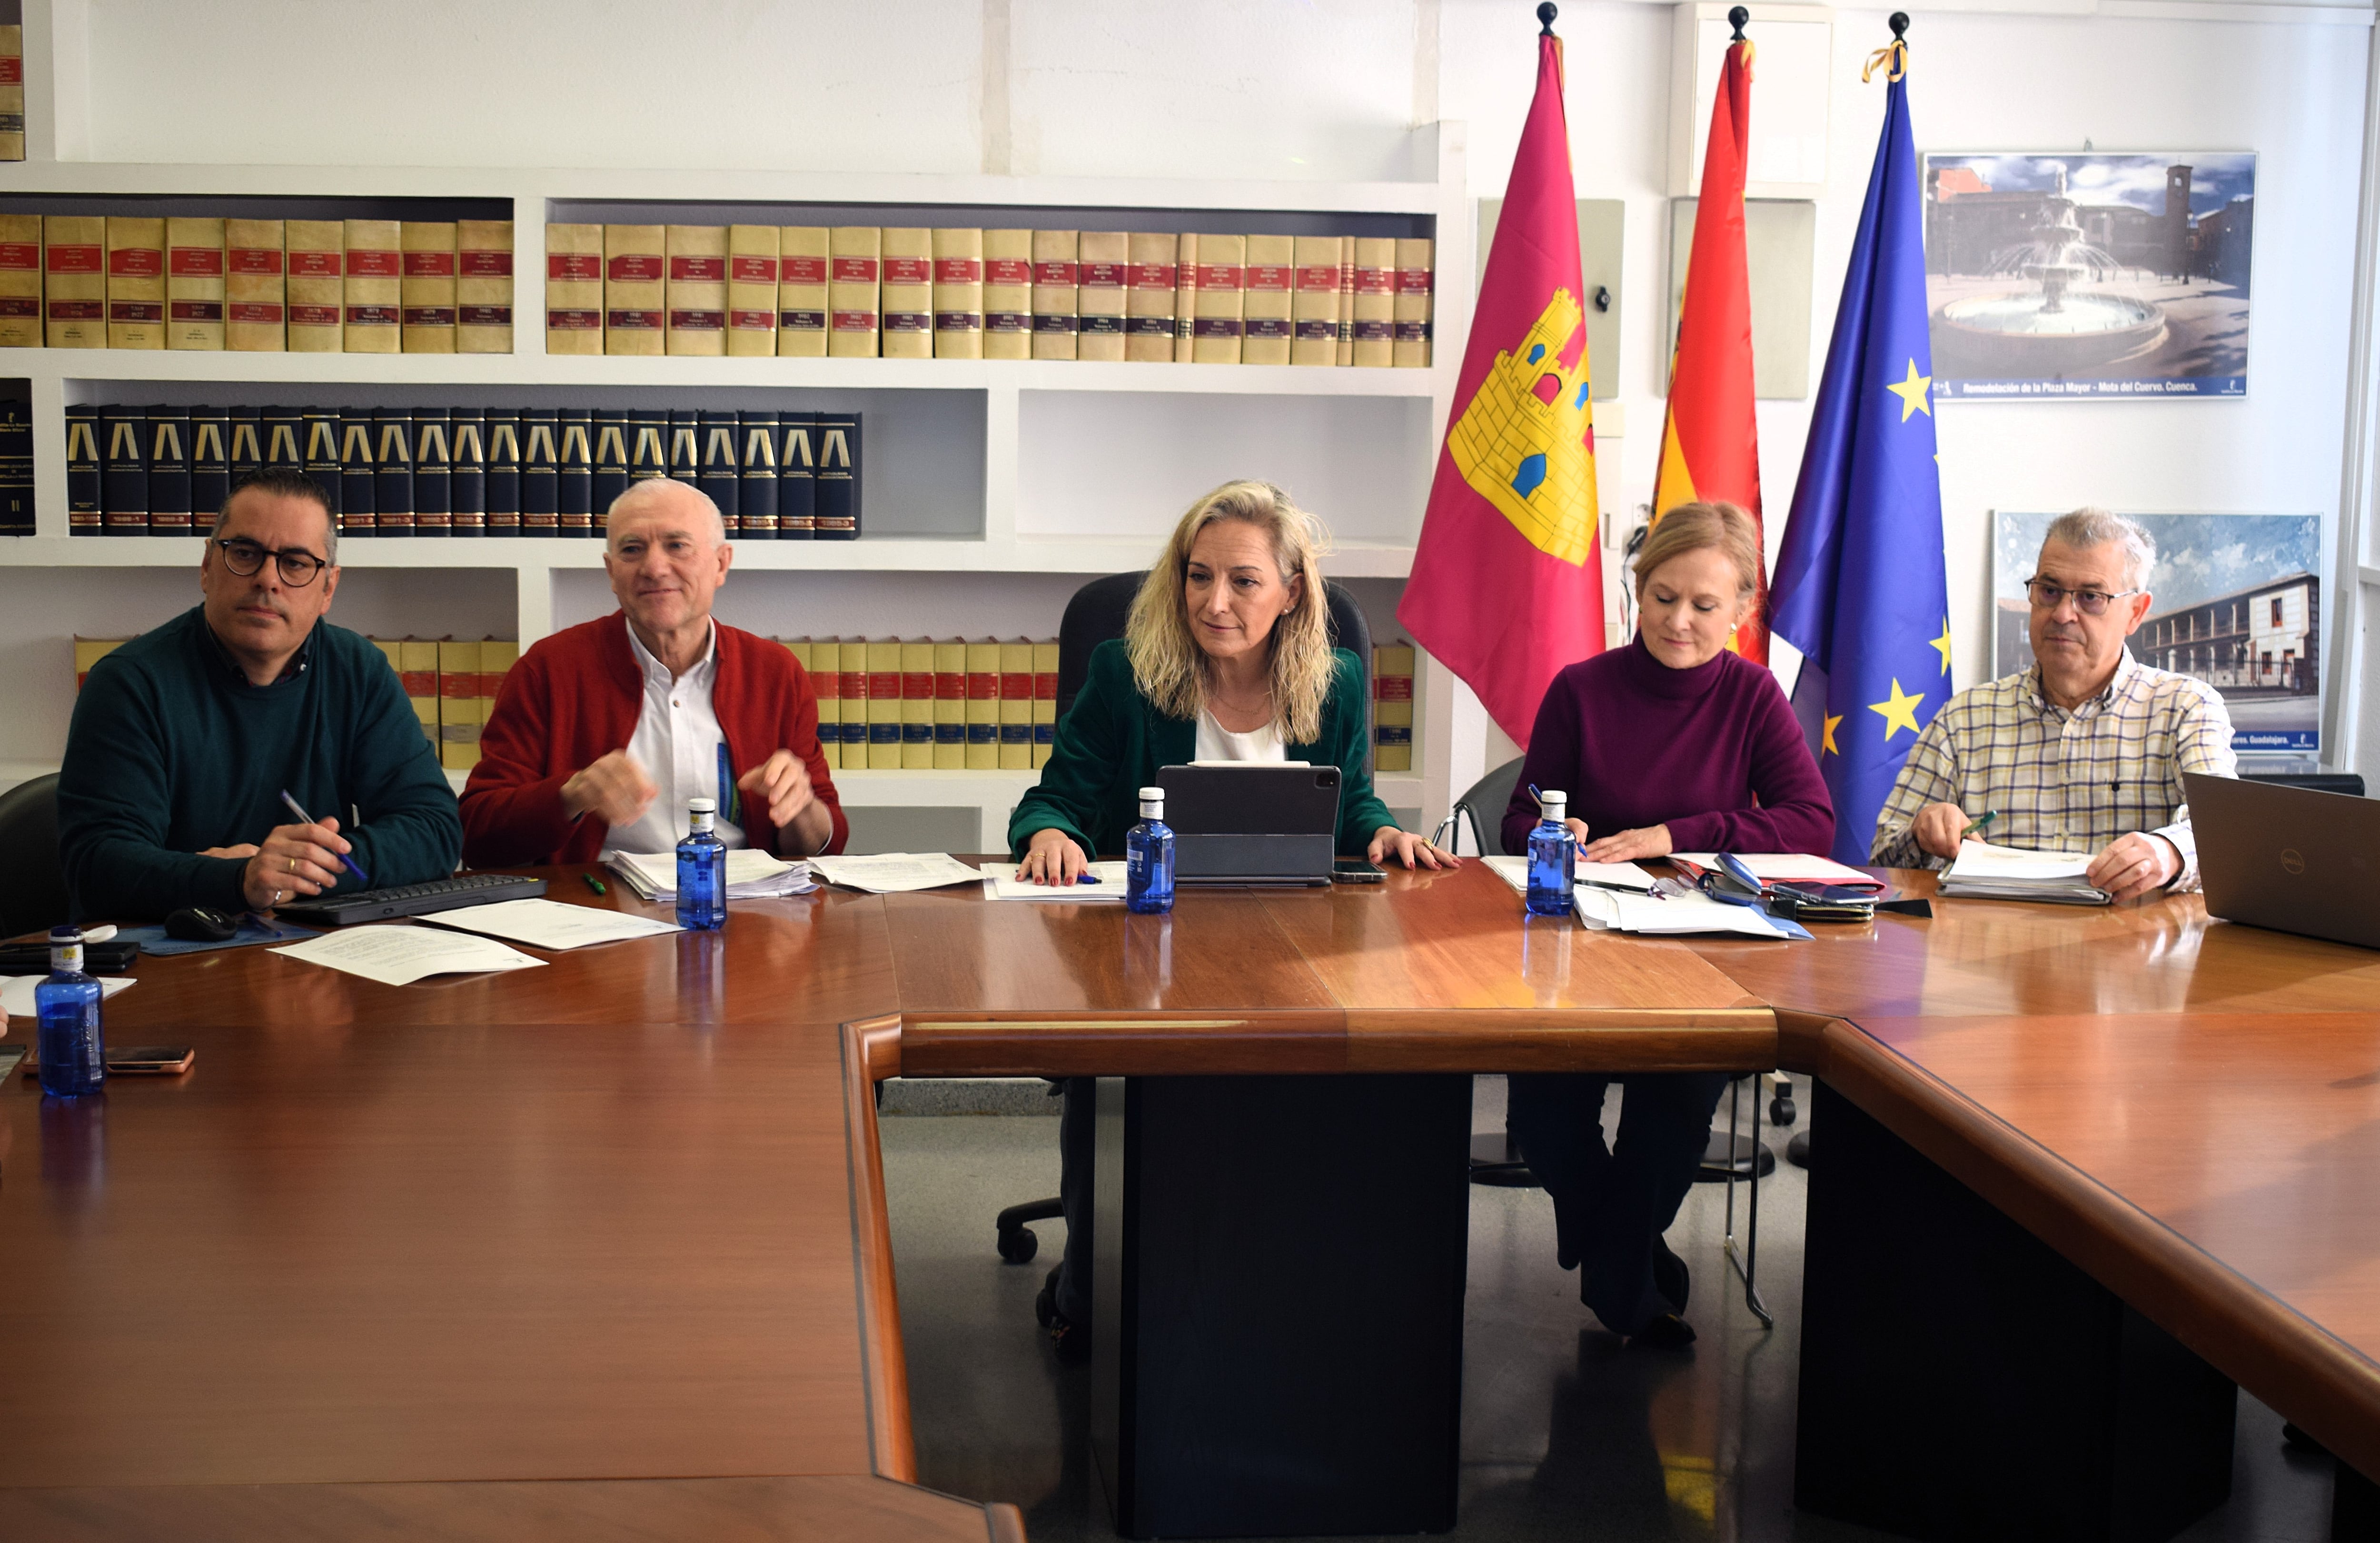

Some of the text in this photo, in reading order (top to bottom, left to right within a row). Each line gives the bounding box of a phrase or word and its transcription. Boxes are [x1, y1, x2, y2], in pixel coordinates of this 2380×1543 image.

[1963, 382, 2020, 394] Remodelación
[2021, 382, 2032, 393] de
[2033, 382, 2041, 393] la
[2042, 382, 2064, 393] Plaza
[2066, 382, 2091, 394] Mayor
[2098, 381, 2118, 392] Mota
[2120, 381, 2132, 392] del
[2134, 381, 2164, 392] Cuervo.
[2165, 381, 2197, 392] Cuenca.
[2250, 735, 2289, 746] Guadalajara.
